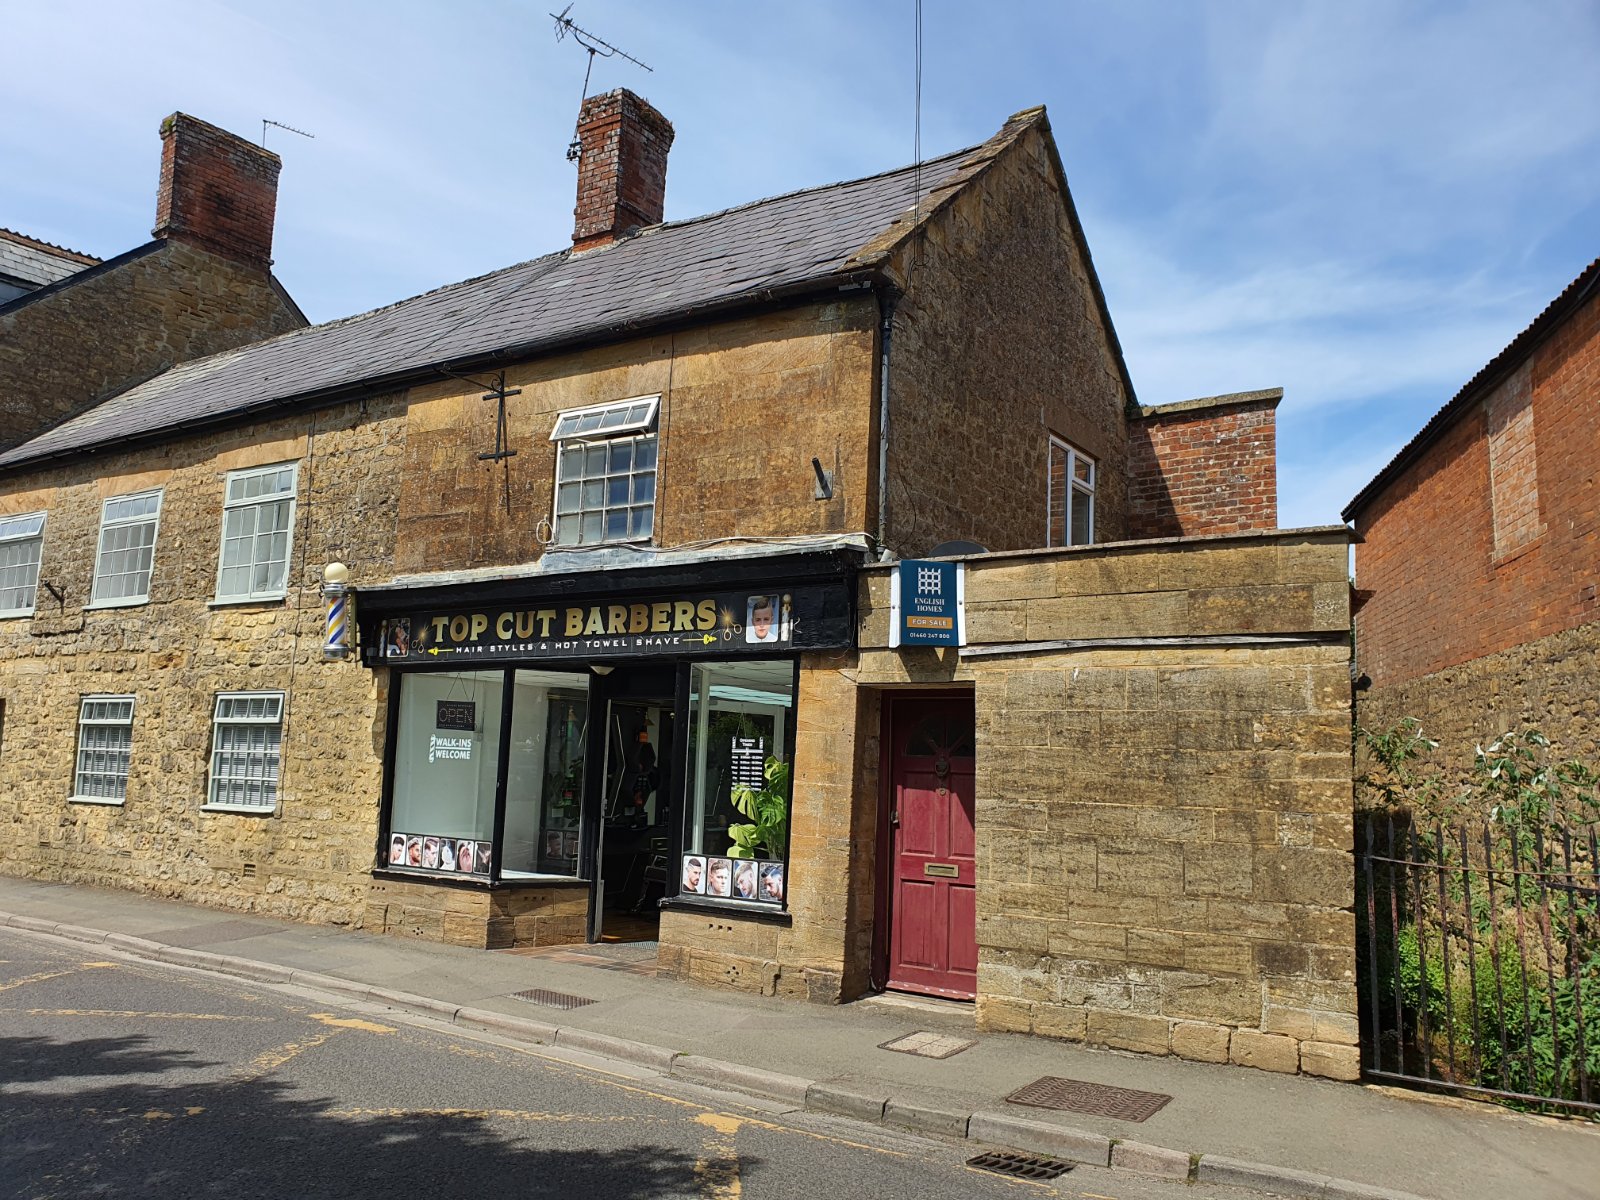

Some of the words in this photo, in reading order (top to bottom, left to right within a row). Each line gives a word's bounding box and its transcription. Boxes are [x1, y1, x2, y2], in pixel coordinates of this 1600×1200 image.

[432, 614, 488, 642] TOP
[496, 610, 556, 640] CUT
[564, 599, 717, 637] BARBERS
[456, 646, 483, 654] HAIR
[490, 643, 533, 652] STYLES
[555, 641, 578, 649] HOT
[585, 639, 628, 648] TOWEL
[636, 637, 680, 646] SHAVE
[439, 708, 472, 723] OPEN
[436, 738, 472, 747] WALK-INS
[436, 750, 470, 759] WELCOME
